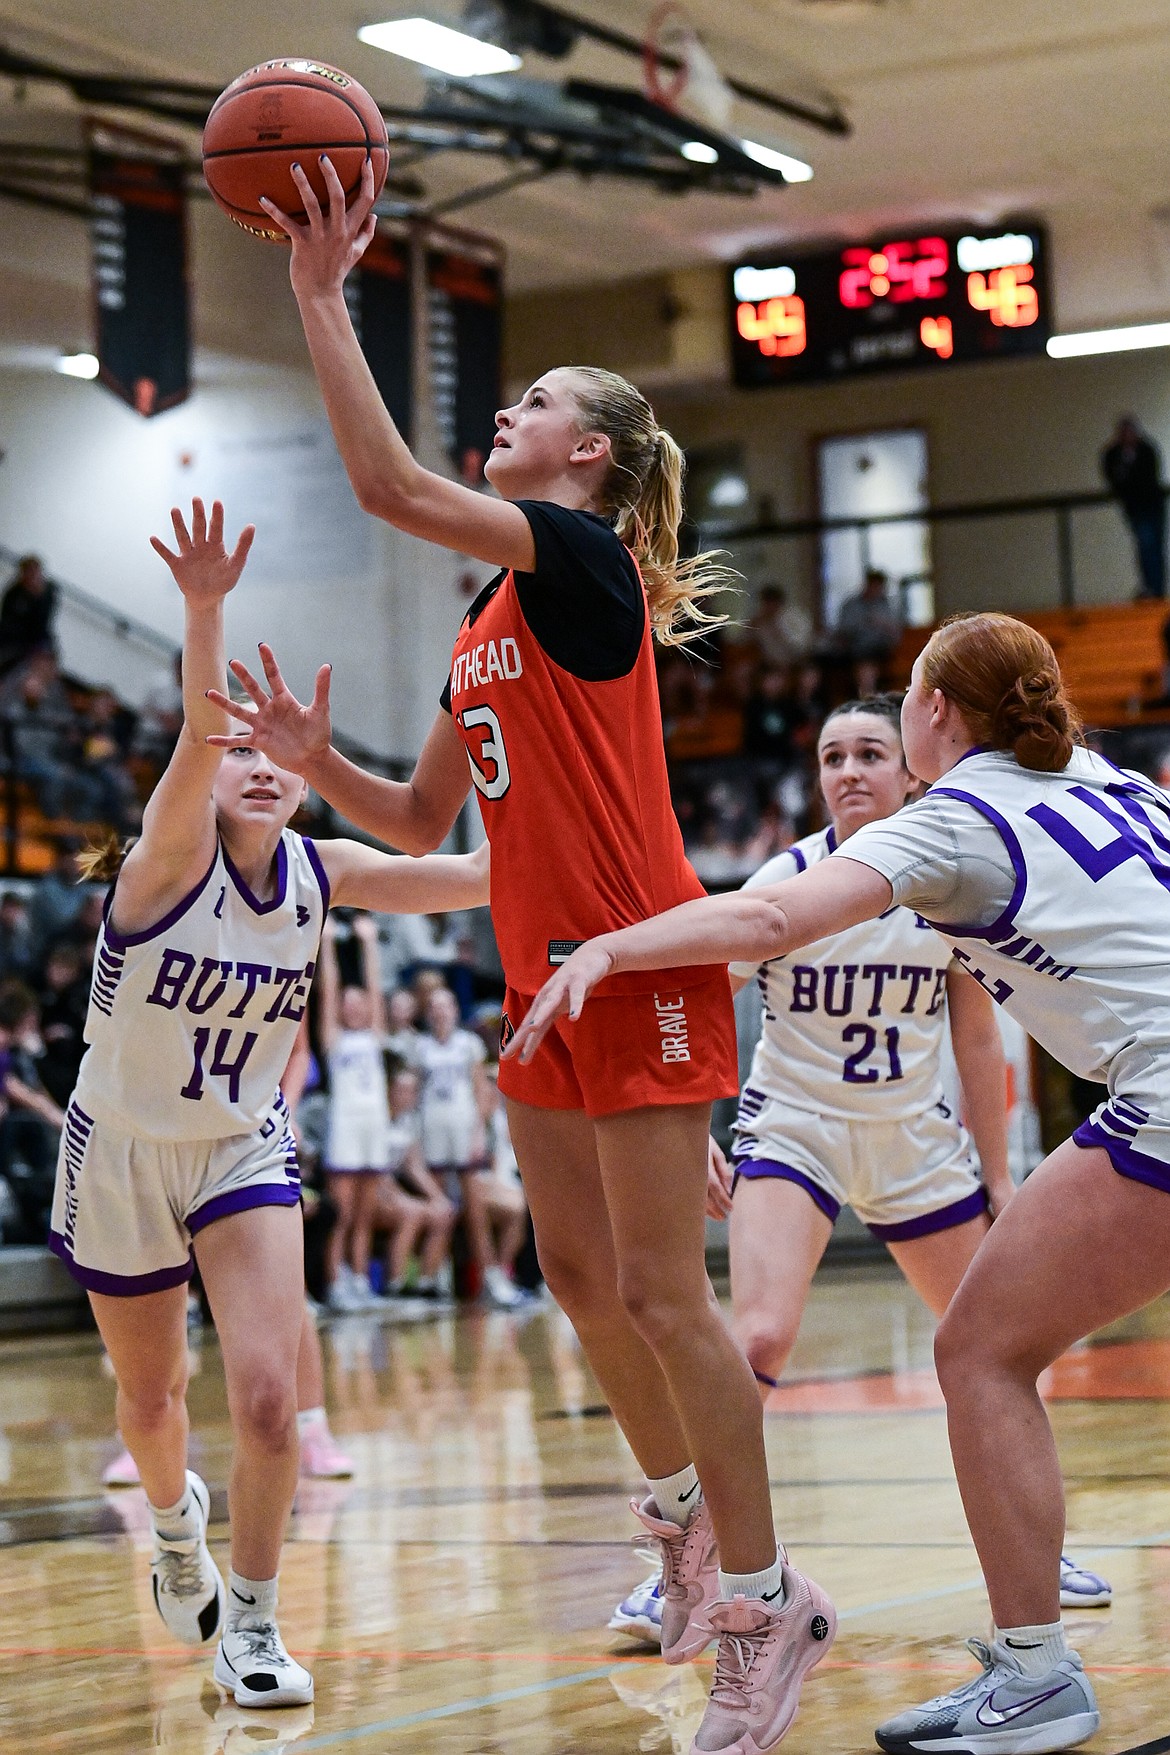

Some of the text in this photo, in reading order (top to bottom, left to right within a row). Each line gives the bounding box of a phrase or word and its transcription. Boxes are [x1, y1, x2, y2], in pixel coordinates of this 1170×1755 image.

[737, 295, 806, 357] 49
[920, 315, 954, 359] 4
[456, 703, 512, 801] 3
[653, 992, 691, 1064] BRAVE
[842, 1023, 904, 1083] 21
[180, 1027, 259, 1103] 14
